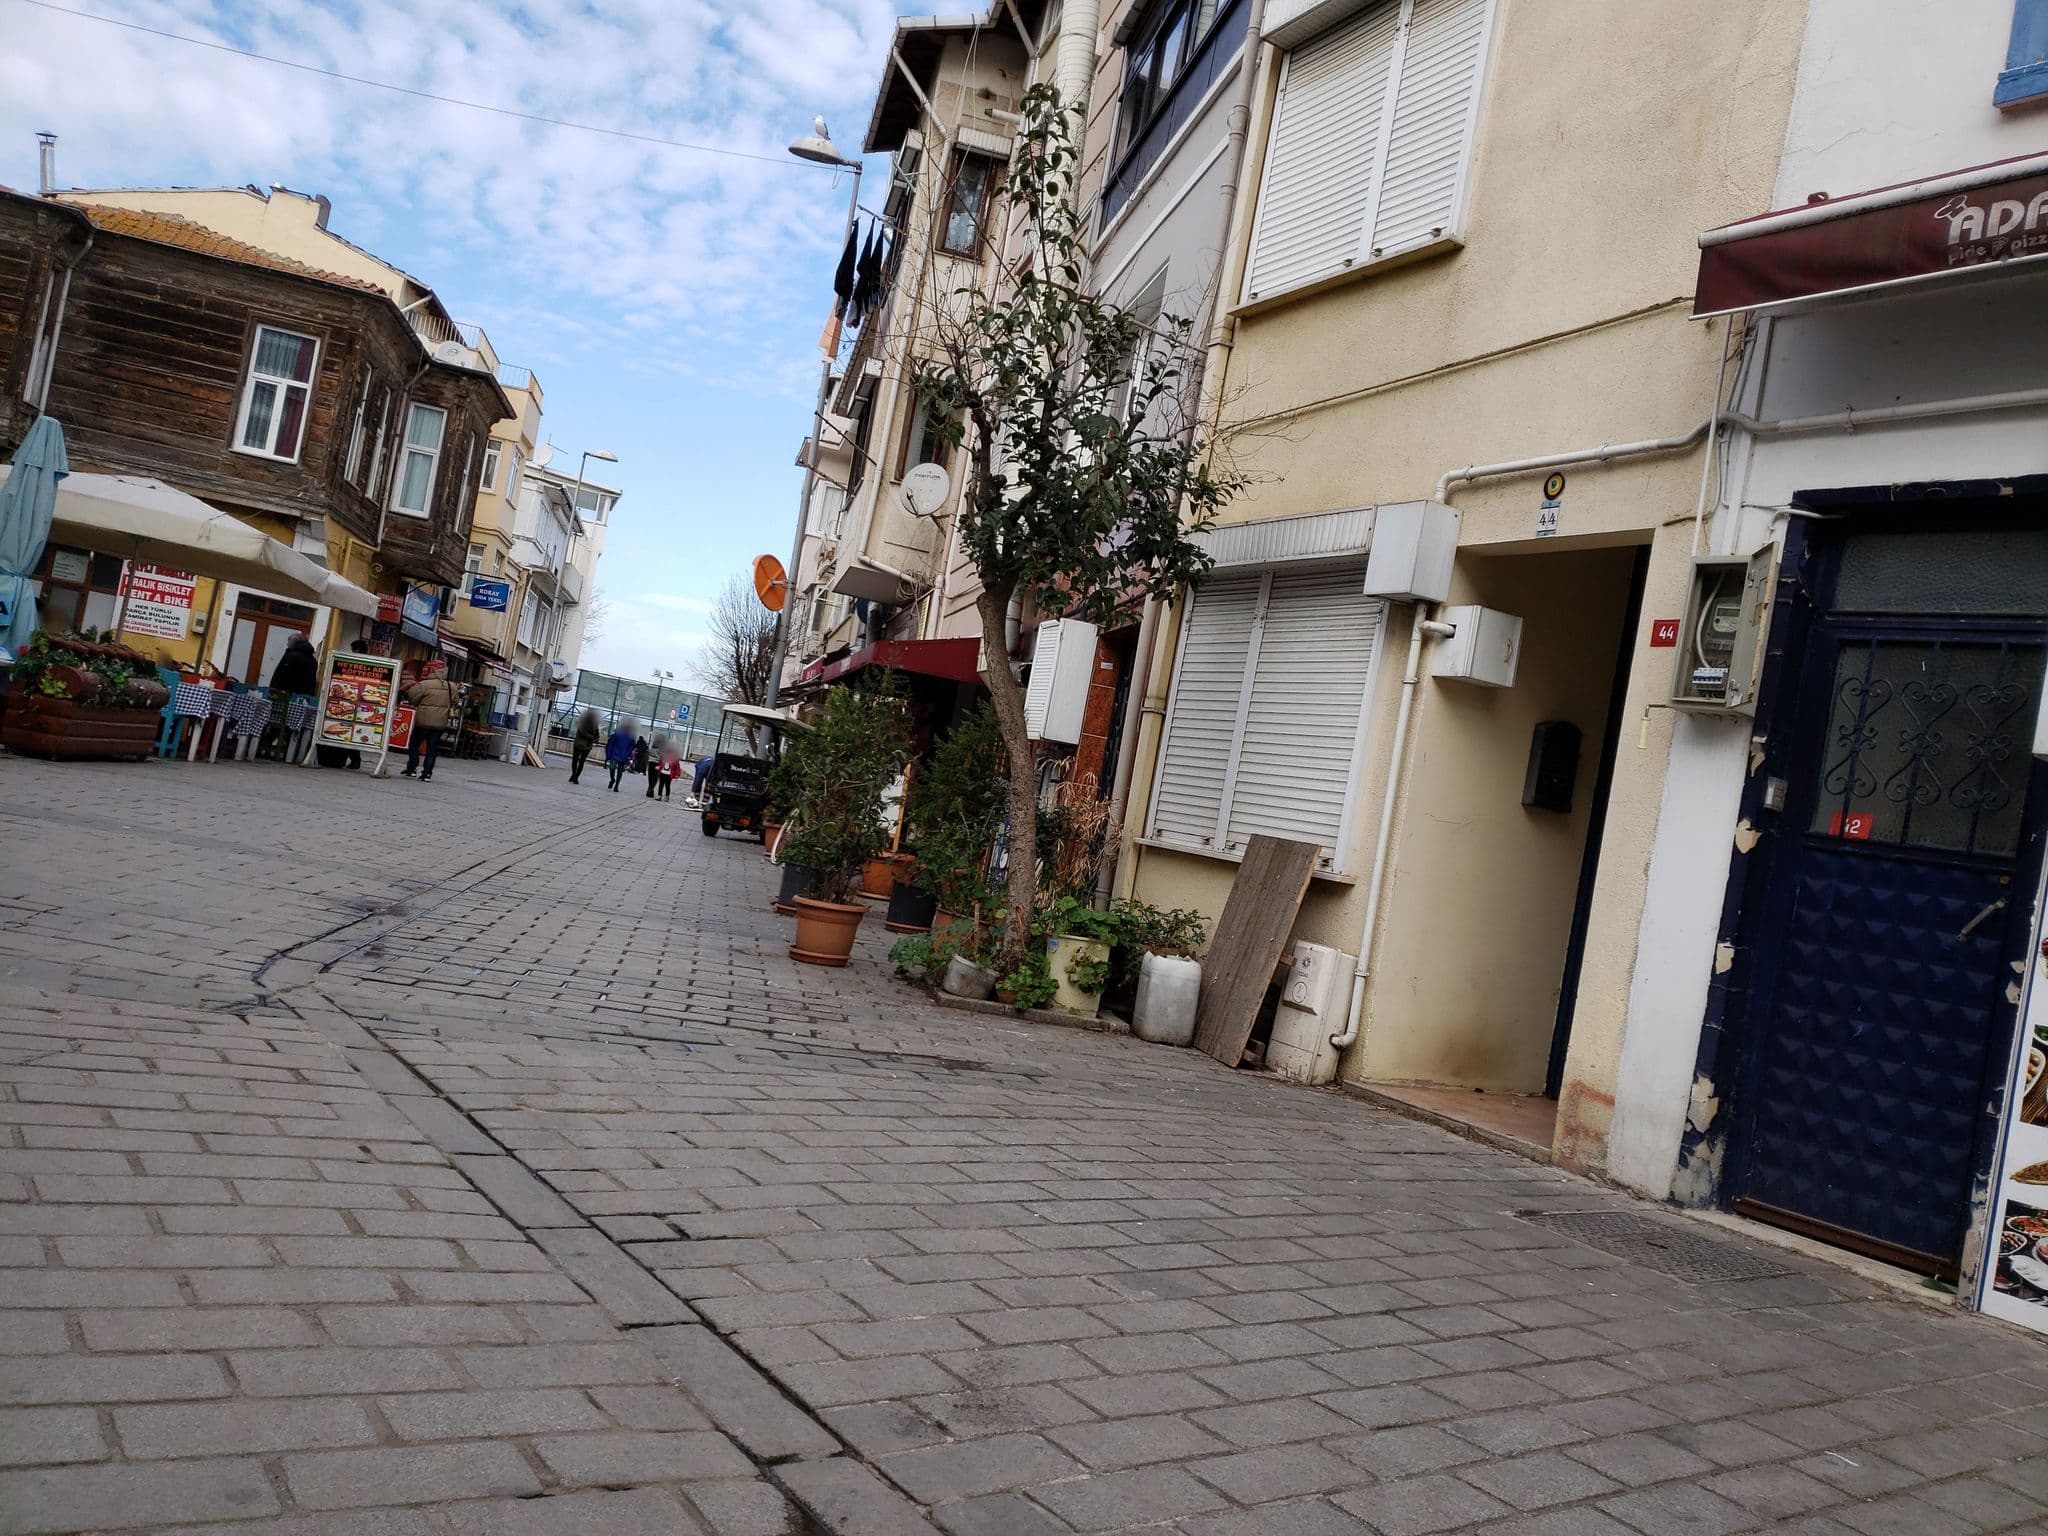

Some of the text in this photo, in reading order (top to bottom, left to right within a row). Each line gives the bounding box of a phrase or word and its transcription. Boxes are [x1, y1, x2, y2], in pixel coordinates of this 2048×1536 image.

[1539, 513, 1557, 526] 44
[479, 589, 500, 597] KORAY
[153, 594, 161, 602] A
[164, 596, 189, 608] BIKE
[1659, 625, 1675, 640] 44
[681, 705, 690, 714] D
